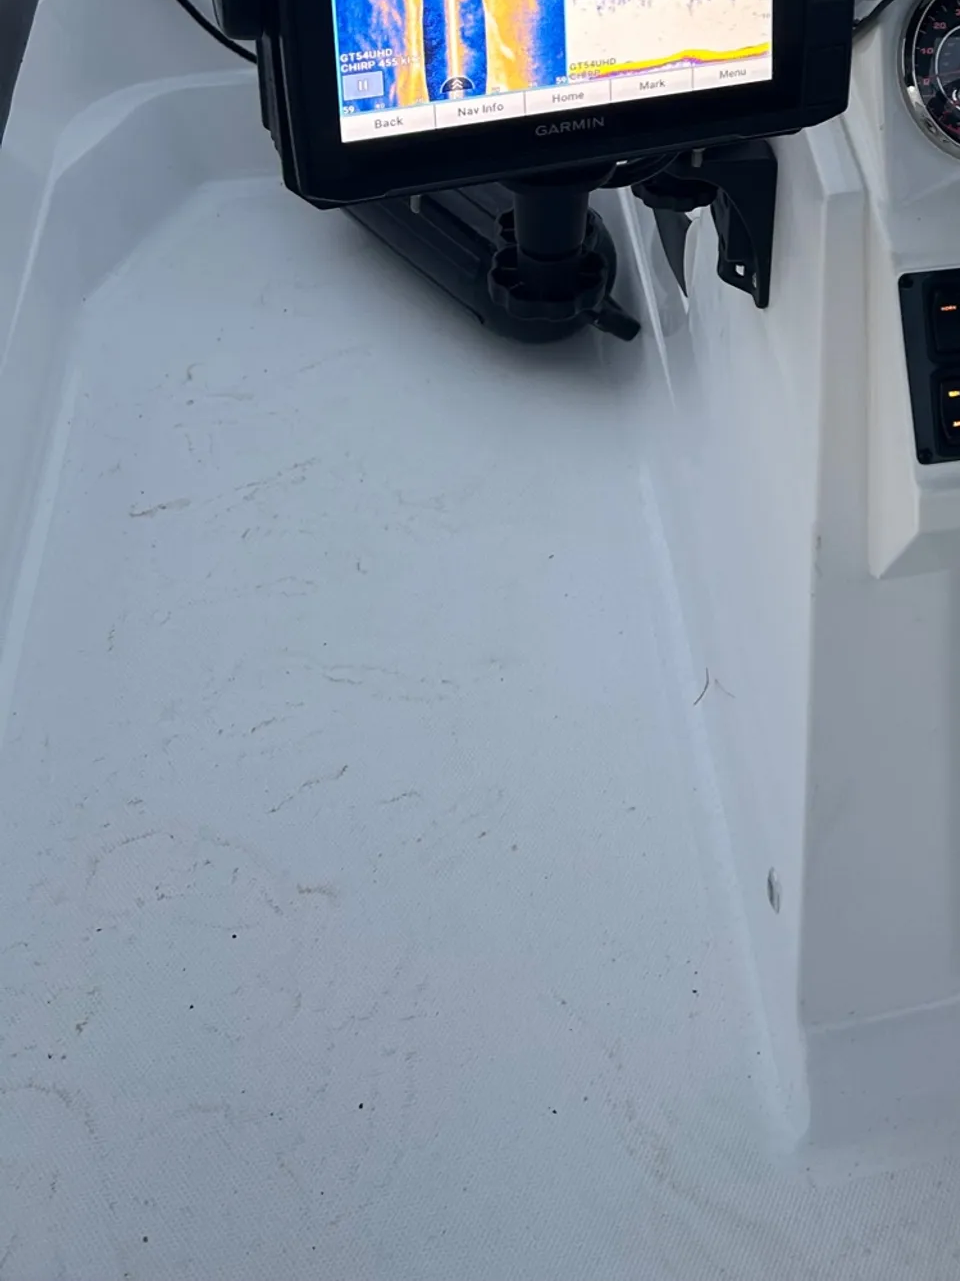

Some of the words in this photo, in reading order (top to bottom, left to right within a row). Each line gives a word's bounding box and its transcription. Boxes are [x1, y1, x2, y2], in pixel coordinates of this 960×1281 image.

[340, 48, 393, 63] GT54UHD
[340, 60, 376, 73] CHIRP
[719, 68, 747, 80] Menu
[638, 79, 667, 91] Mark
[551, 91, 586, 104] Home
[457, 105, 480, 117] Nav
[482, 102, 504, 114] Info
[374, 116, 404, 129] Back
[535, 116, 606, 137] GARMIN
